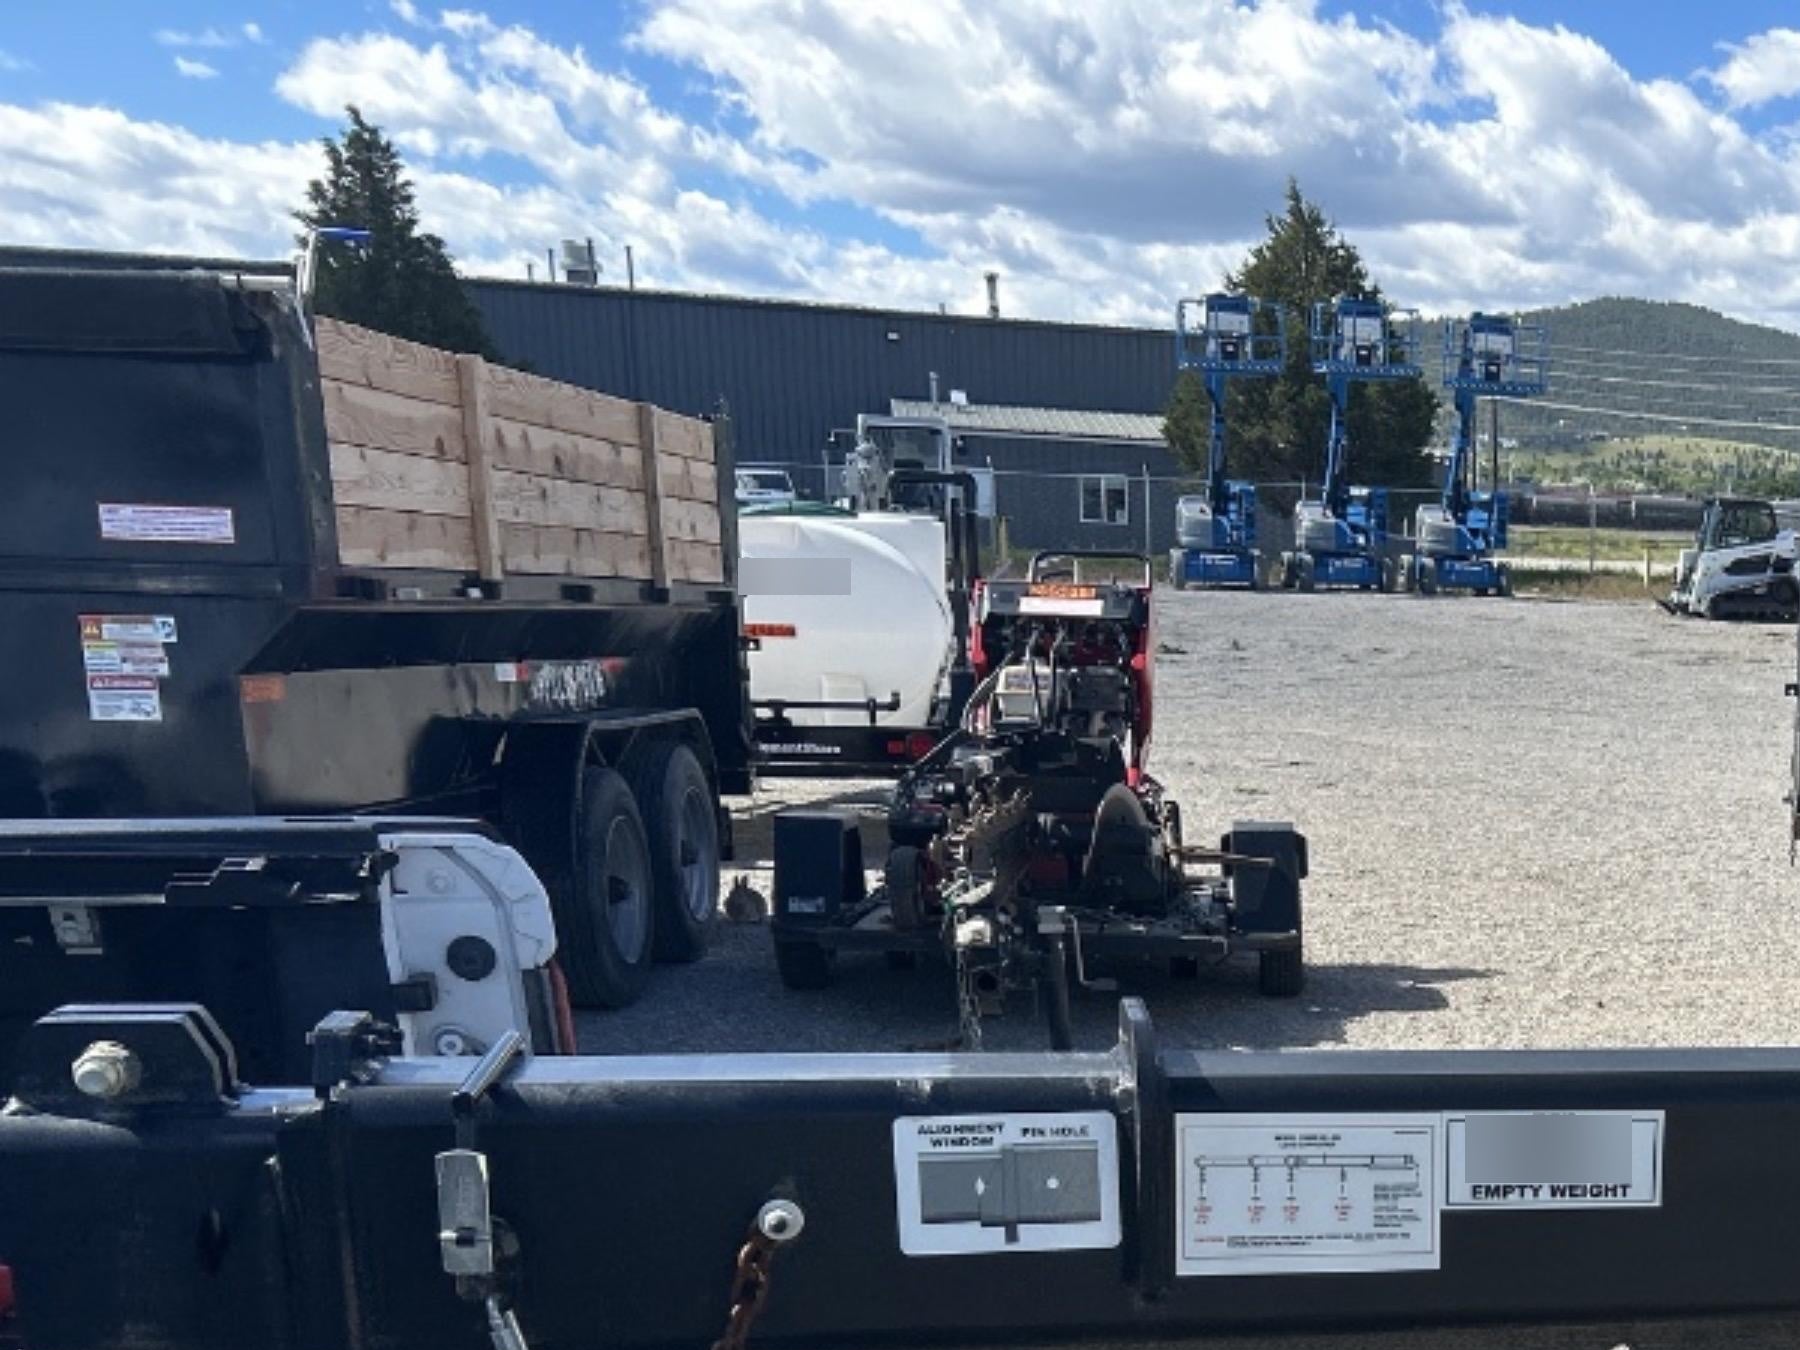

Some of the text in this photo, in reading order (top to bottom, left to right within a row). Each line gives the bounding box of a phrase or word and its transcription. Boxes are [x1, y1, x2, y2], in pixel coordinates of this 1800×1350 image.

[917, 1122, 1005, 1135] ALIGNMENT
[1472, 1183, 1632, 1200] EMPTY WEIGHT
